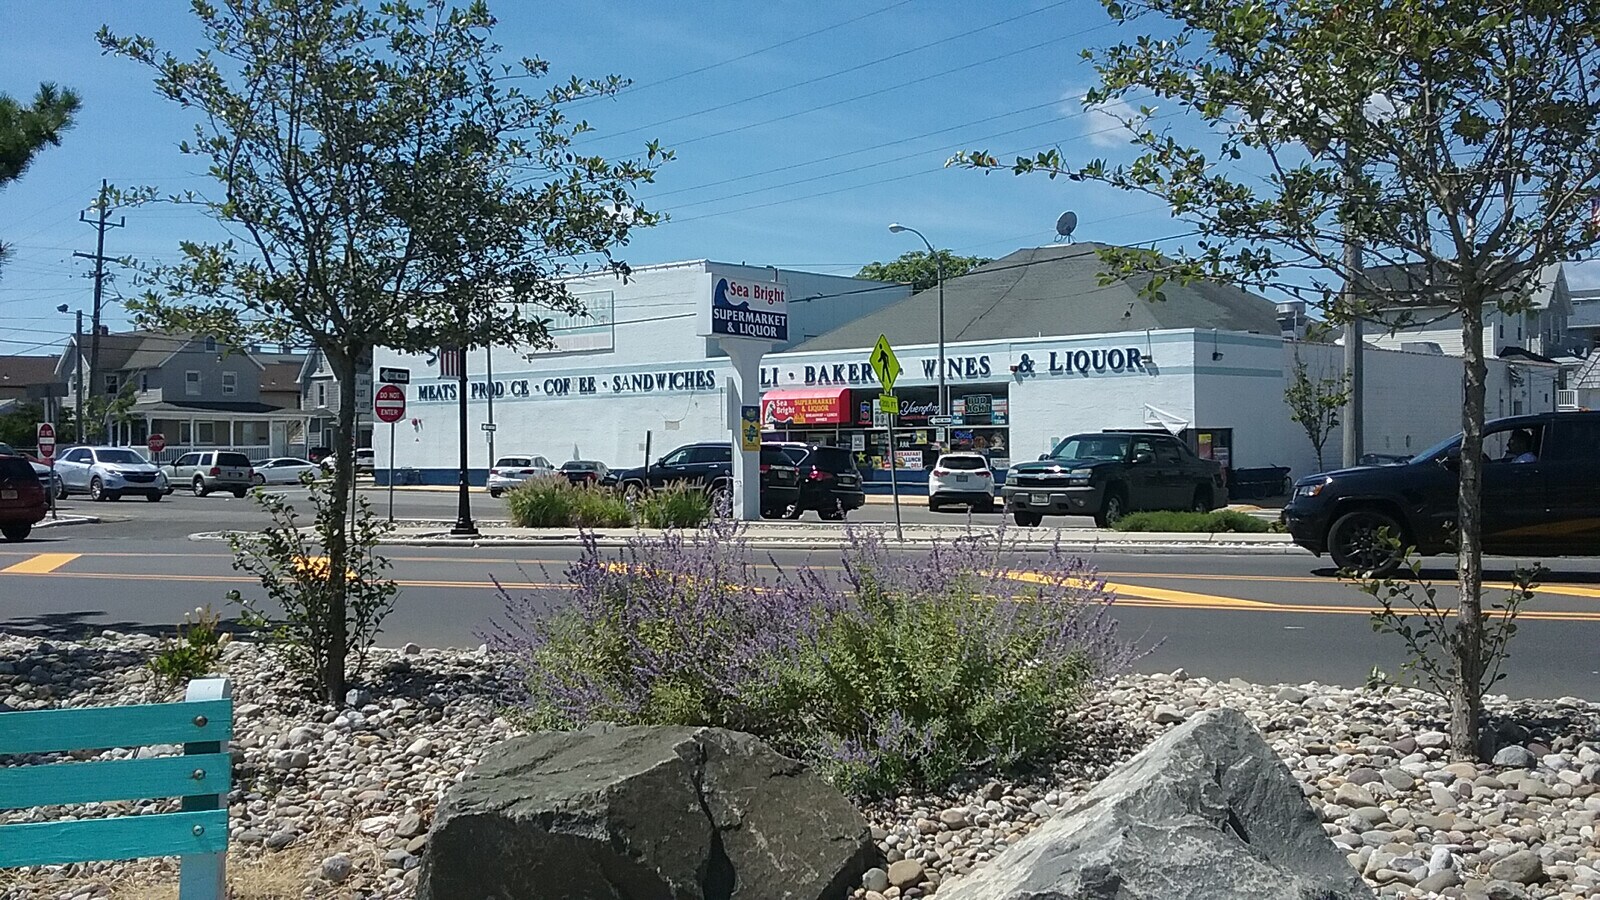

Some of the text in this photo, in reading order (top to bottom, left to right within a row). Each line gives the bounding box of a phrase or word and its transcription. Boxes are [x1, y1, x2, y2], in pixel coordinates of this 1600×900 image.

[730, 281, 785, 305] Sea Bright
[713, 308, 786, 326] SUPERMARKET
[727, 321, 778, 337] & LIQUOR
[760, 348, 1144, 387] LI BAKER WNES & LIQUOR
[418, 383, 457, 401] MEATS
[612, 370, 716, 394] SANDWICHES
[794, 398, 836, 406] SUPERMARKET
[900, 400, 940, 415] Yuengling
[965, 403, 991, 413] LIGHT
[967, 396, 988, 405] BUD
[776, 406, 795, 416] Bright
[808, 404, 830, 412] LIQUOR
